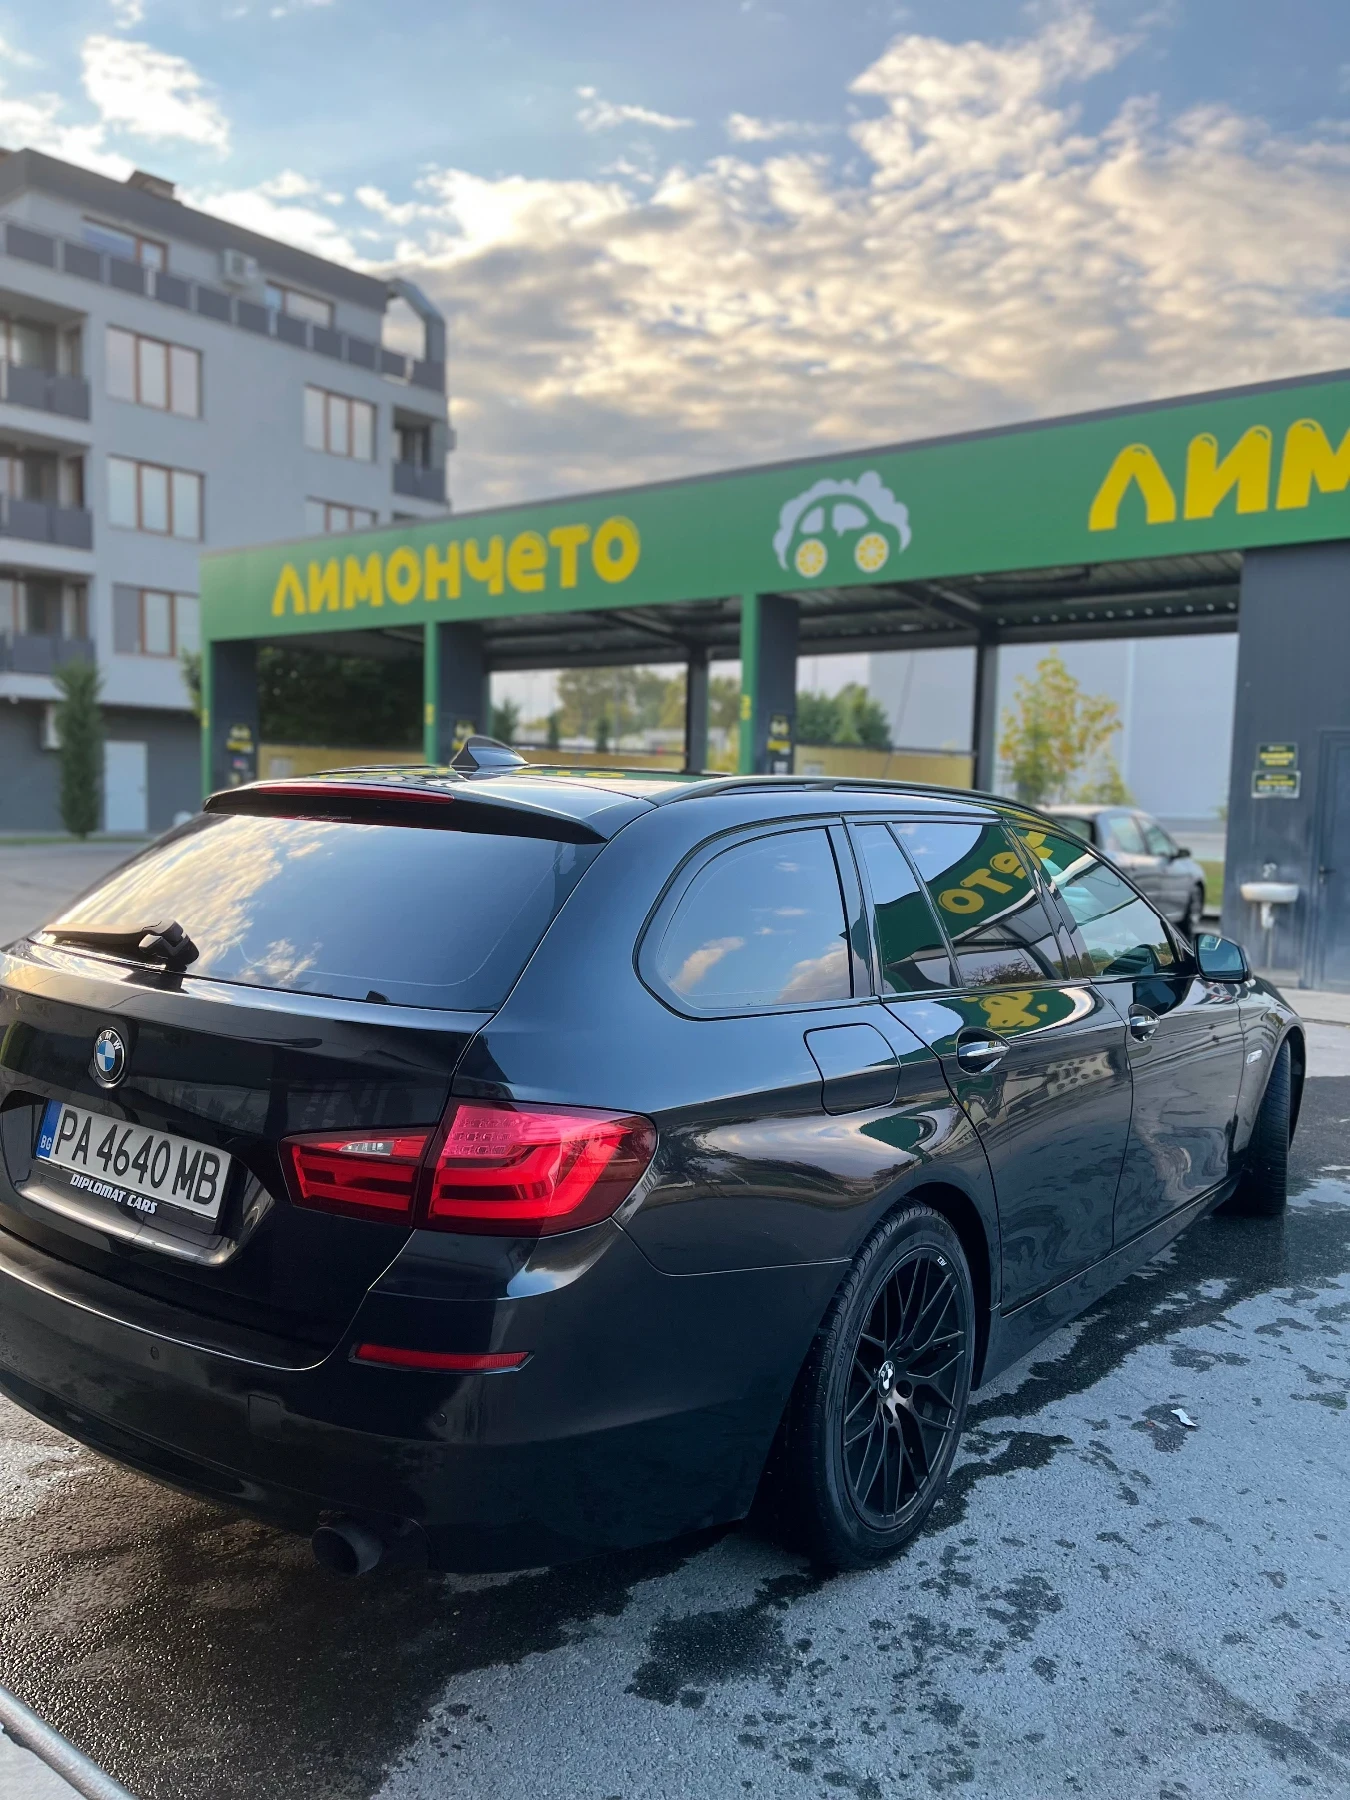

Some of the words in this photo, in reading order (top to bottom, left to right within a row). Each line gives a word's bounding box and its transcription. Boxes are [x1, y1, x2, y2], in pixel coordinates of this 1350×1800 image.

[40, 1134, 52, 1151] BG
[54, 1109, 93, 1165] PA
[96, 1123, 171, 1189] 4640
[171, 1144, 221, 1205] MB
[69, 1173, 126, 1204] DIPLOMAT
[127, 1192, 158, 1215] CARS
